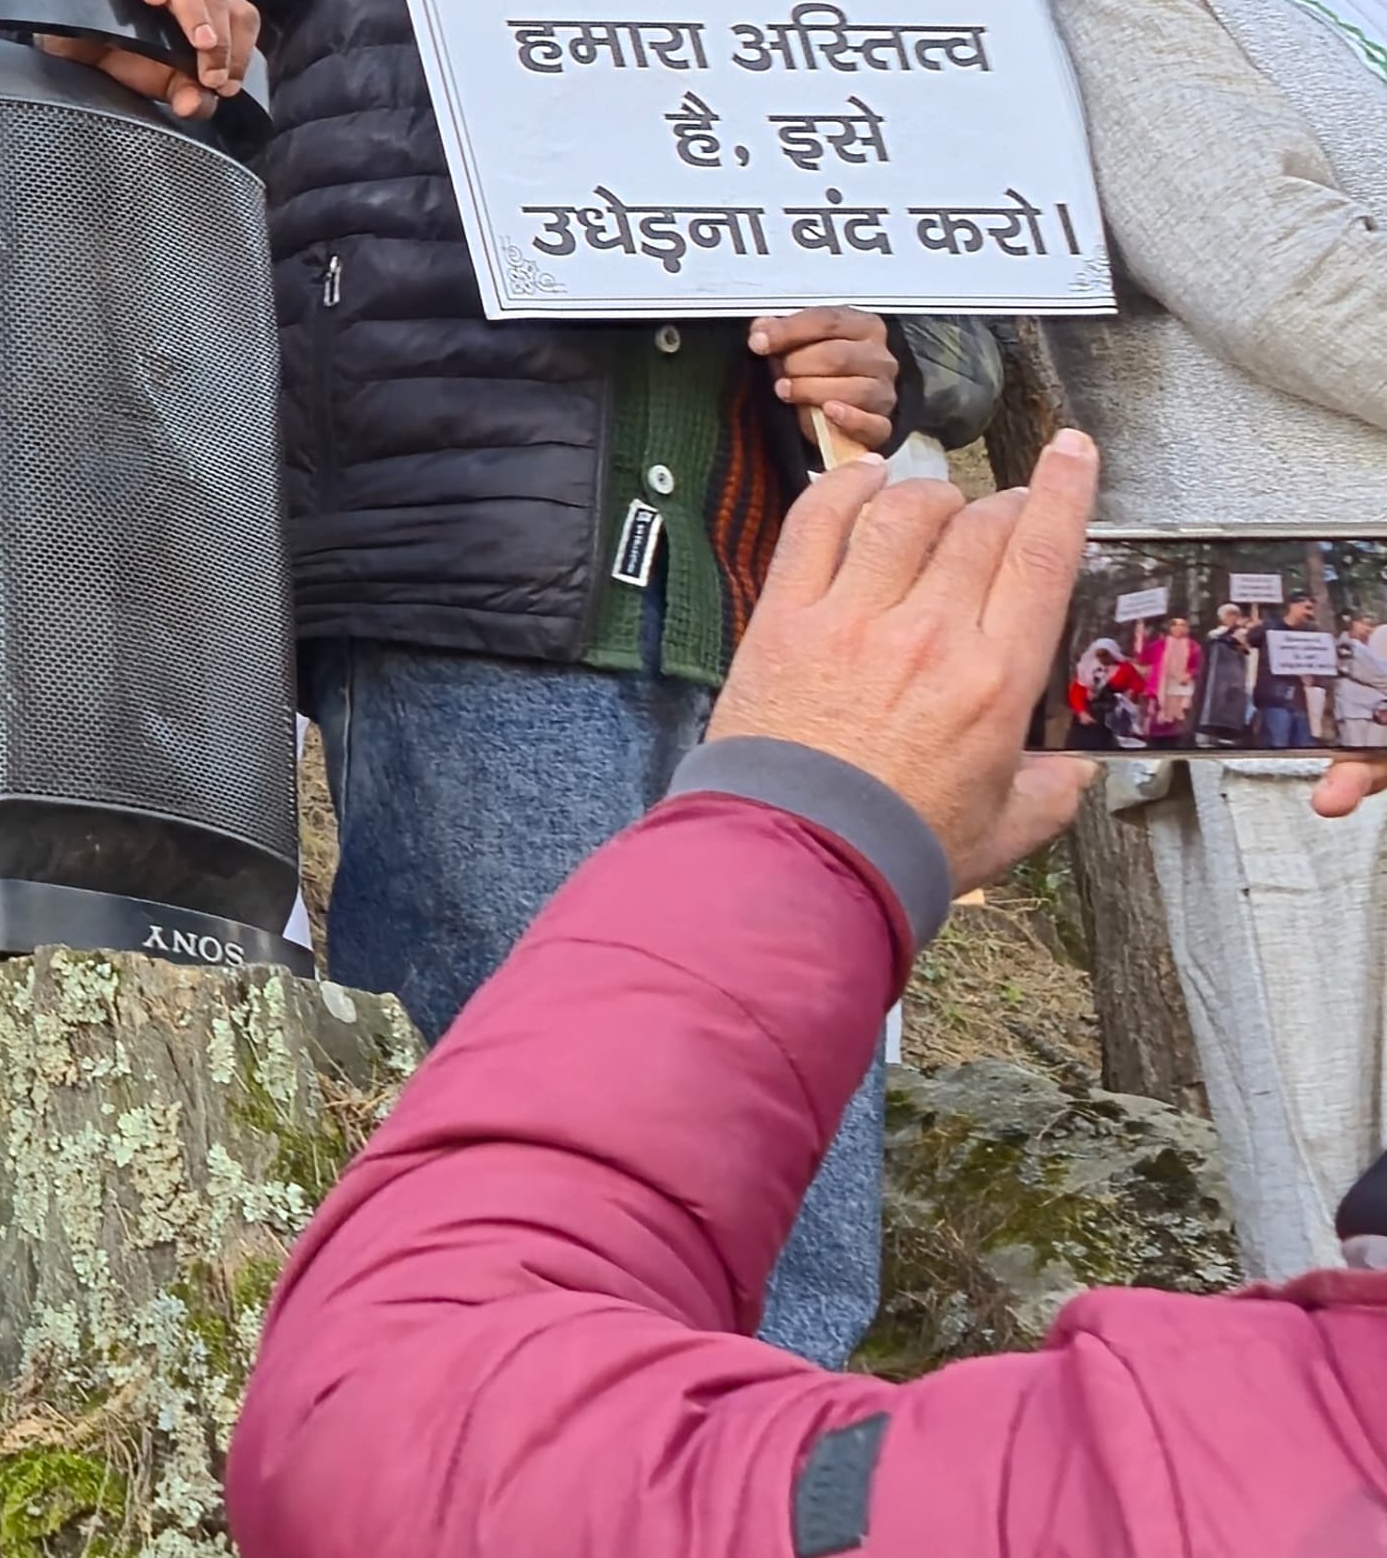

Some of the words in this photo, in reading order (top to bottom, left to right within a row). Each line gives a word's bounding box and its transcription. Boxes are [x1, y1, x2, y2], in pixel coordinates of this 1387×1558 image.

[506, 20, 709, 73] हमारा
[730, 3, 992, 73] अस्तित्व
[664, 92, 749, 169] है,
[768, 97, 890, 171] इसे
[521, 186, 770, 274] उधेड़ना
[783, 188, 894, 256] बंद
[142, 925, 245, 967] SONY
